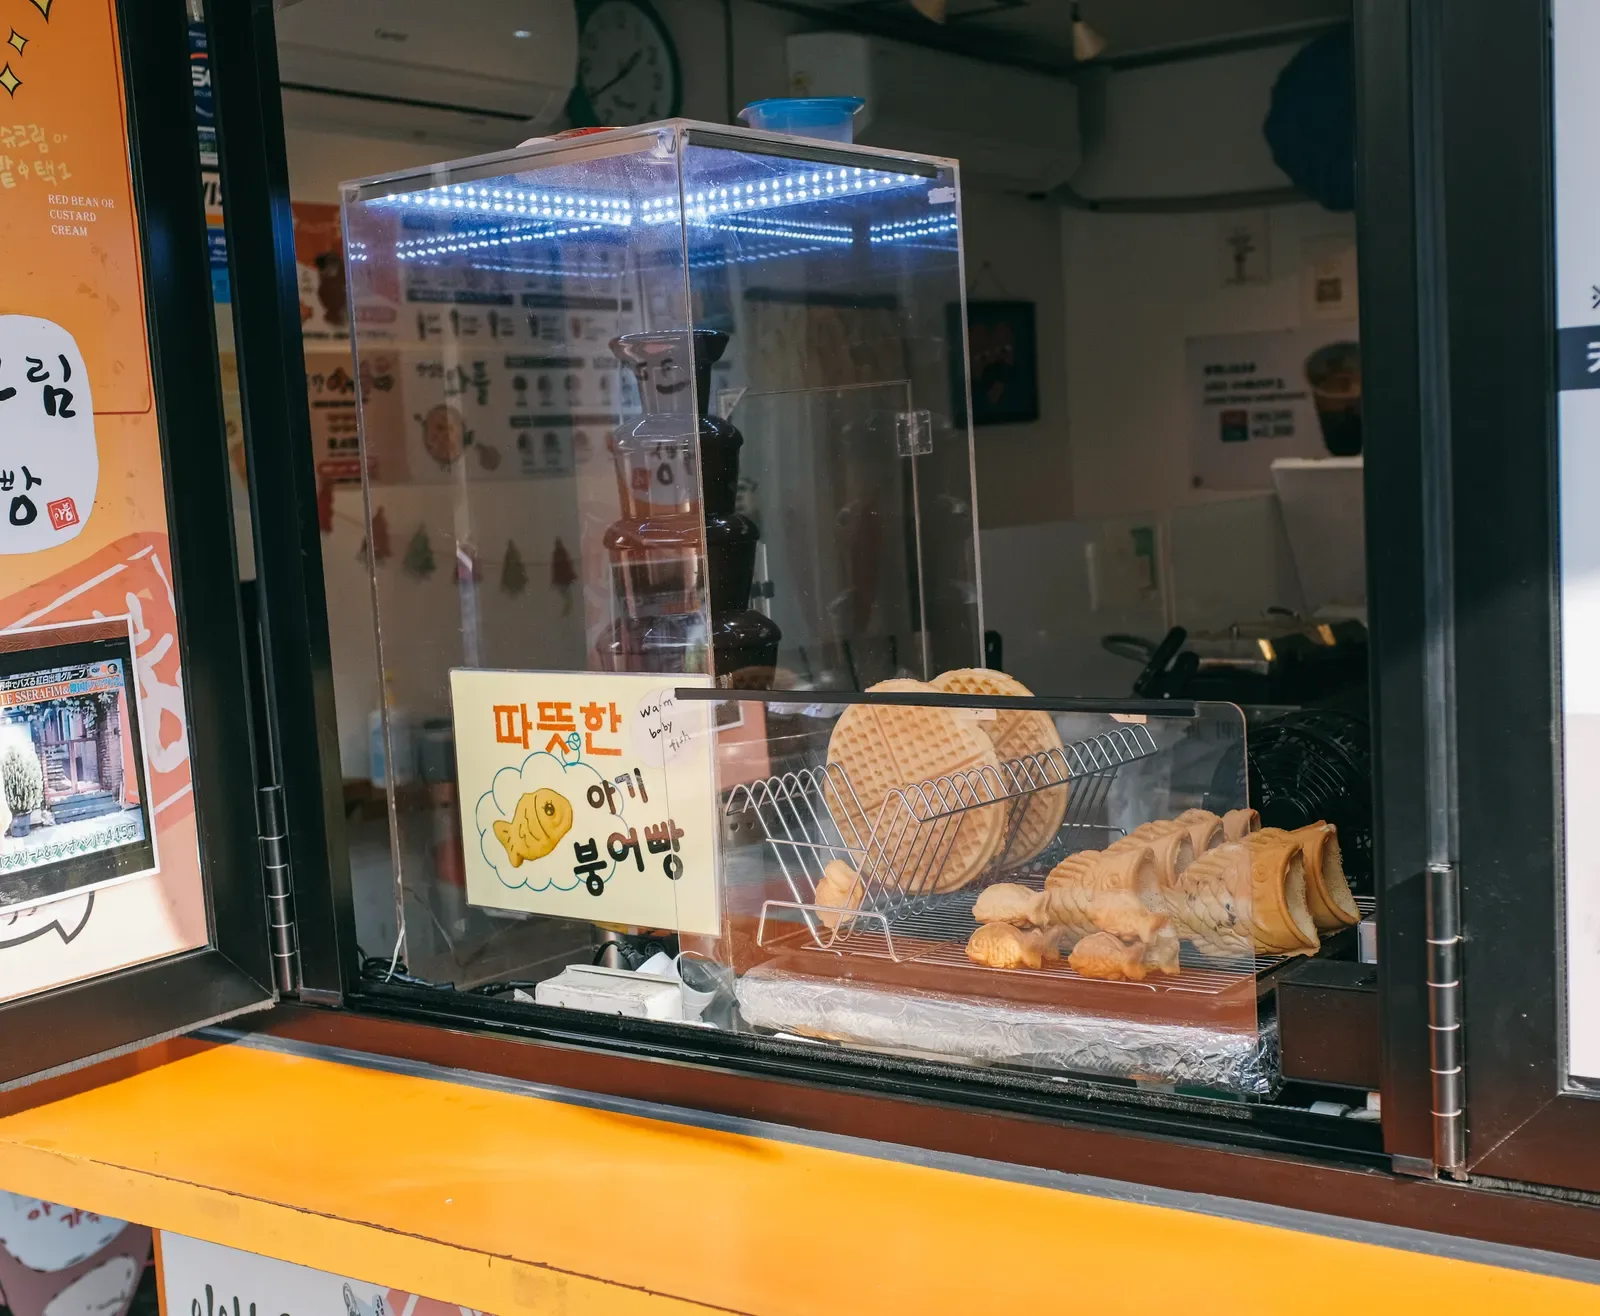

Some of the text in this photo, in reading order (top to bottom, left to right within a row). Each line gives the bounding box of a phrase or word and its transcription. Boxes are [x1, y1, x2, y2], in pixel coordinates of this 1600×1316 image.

[0, 124, 48, 153] 슈크림
[48, 193, 115, 208] RED BEAN OR
[49, 209, 97, 222] CUSTARD
[51, 224, 88, 237] CREAM
[493, 701, 622, 756] 따뜻한
[648, 720, 672, 739] baby
[586, 767, 648, 815] 아기
[573, 818, 685, 897] 붕어빵
